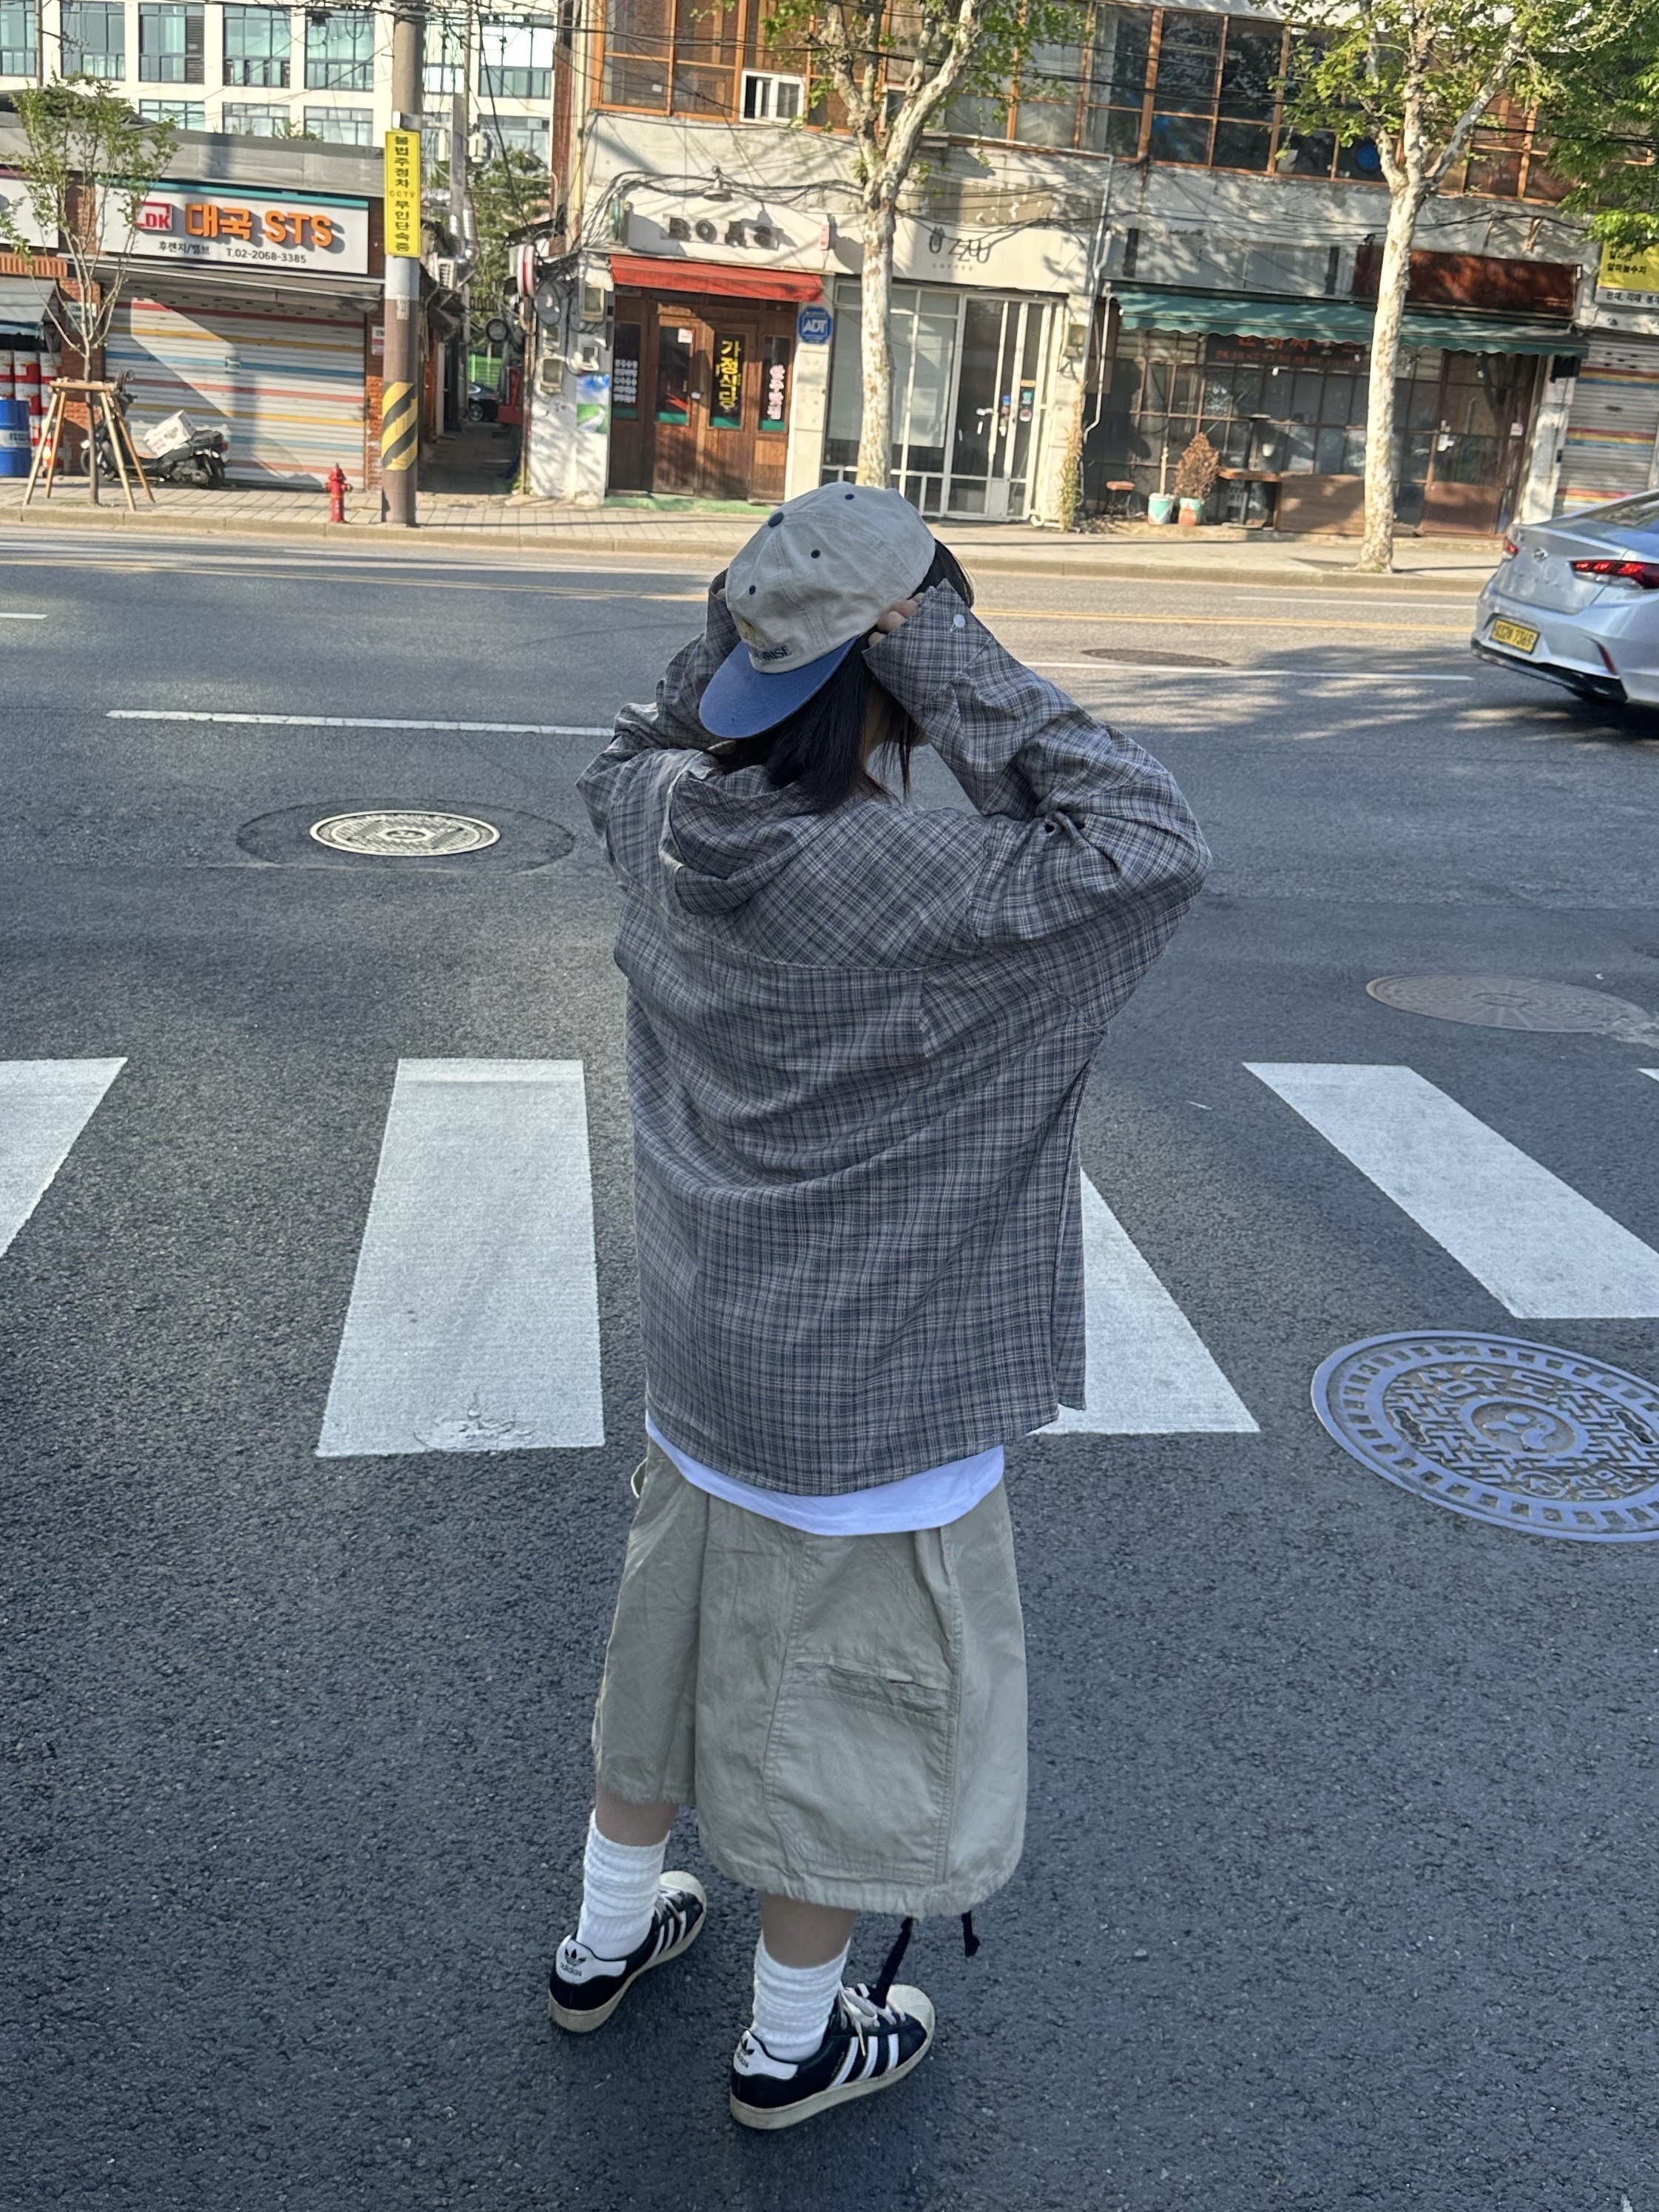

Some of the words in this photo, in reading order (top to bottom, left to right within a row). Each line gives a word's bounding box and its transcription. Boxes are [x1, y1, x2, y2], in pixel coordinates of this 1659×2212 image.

[394, 135, 410, 188] 불법주정차
[389, 189, 416, 198] CCTV
[185, 203, 253, 241] 대국
[265, 209, 334, 248] STS
[394, 200, 410, 252] 무인단속중
[226, 248, 307, 264] T.02-2068-3385
[803, 317, 828, 334] ADT
[718, 339, 741, 410] 가정식당
